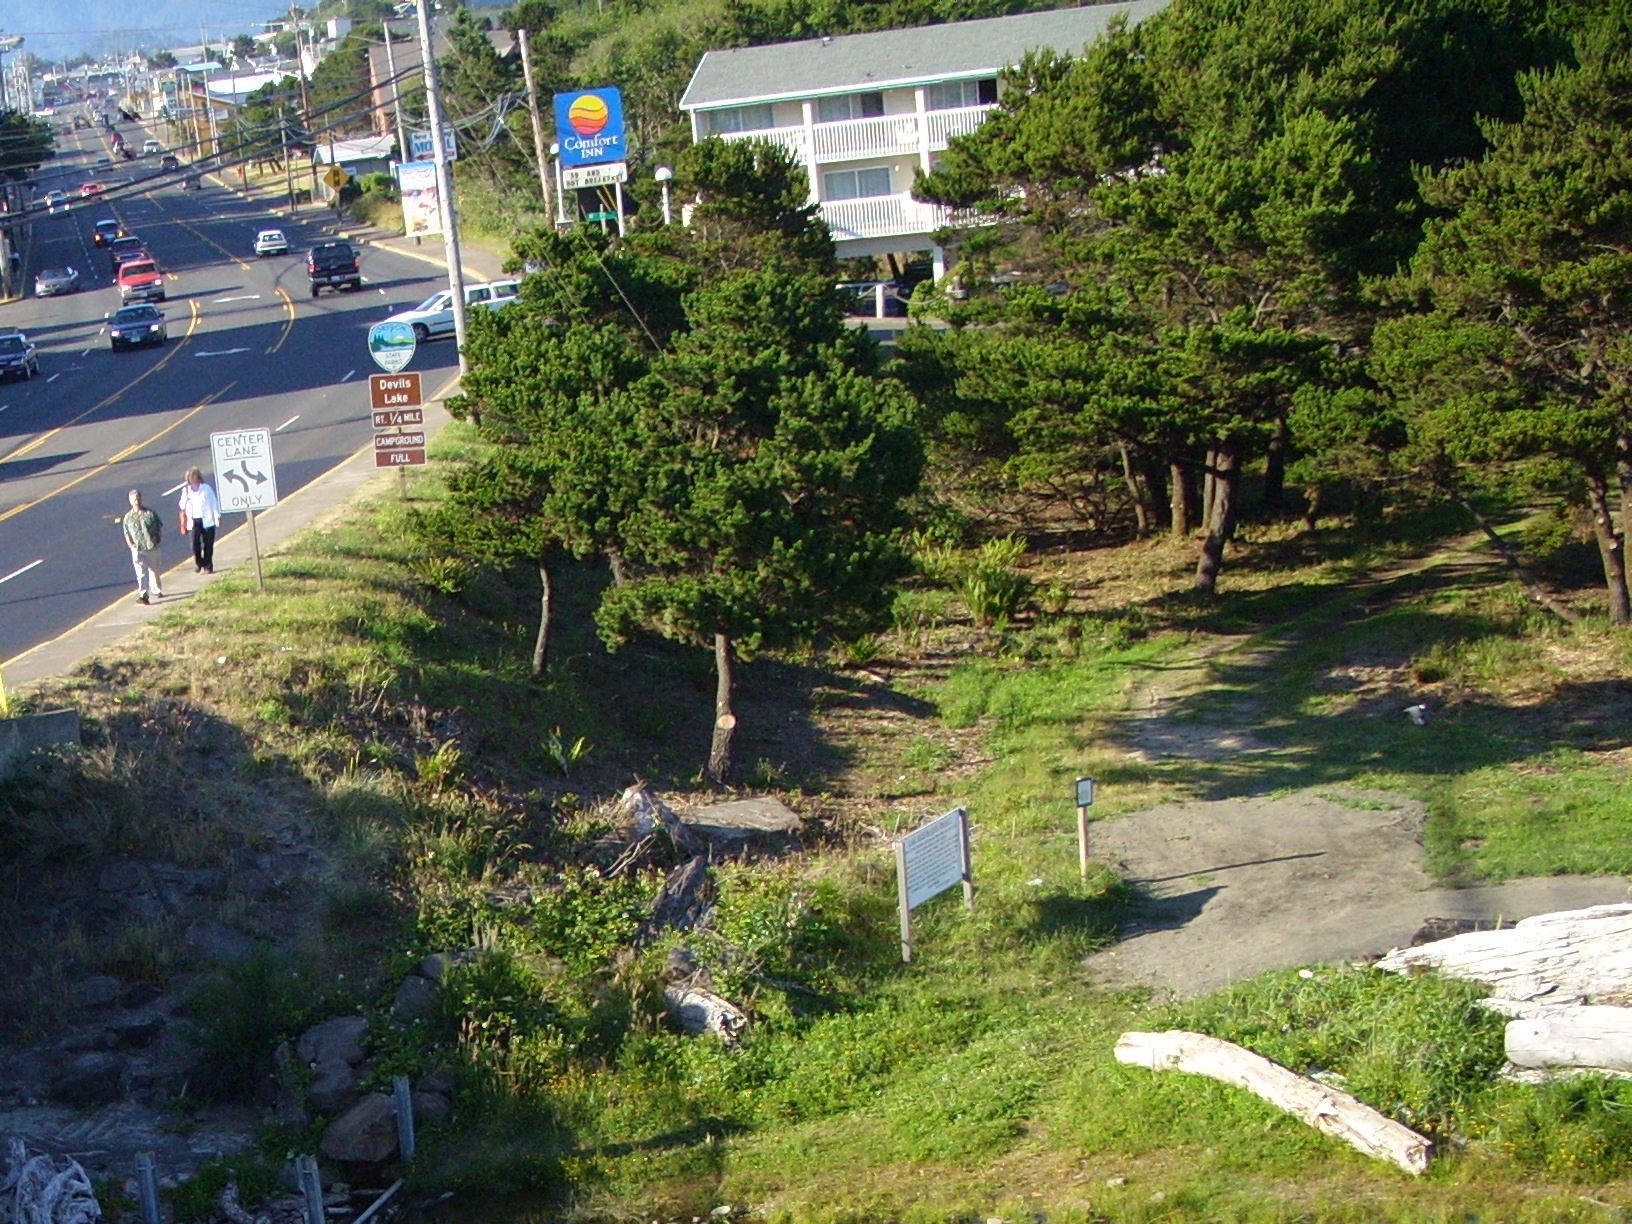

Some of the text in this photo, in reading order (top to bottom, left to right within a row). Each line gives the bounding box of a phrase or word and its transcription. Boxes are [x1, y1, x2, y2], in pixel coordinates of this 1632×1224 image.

[414, 138, 454, 153] MOL
[564, 133, 619, 151] Comfort
[580, 147, 604, 159] INN
[379, 379, 412, 390] Devils
[384, 393, 409, 404] Lake
[389, 412, 402, 425] 1/4
[403, 411, 421, 422] MILE
[217, 434, 263, 447] CENTER
[376, 435, 424, 447] CAMPGROUND
[226, 446, 258, 457] LANE
[390, 454, 410, 463] FULL
[232, 495, 262, 506] ONLY
